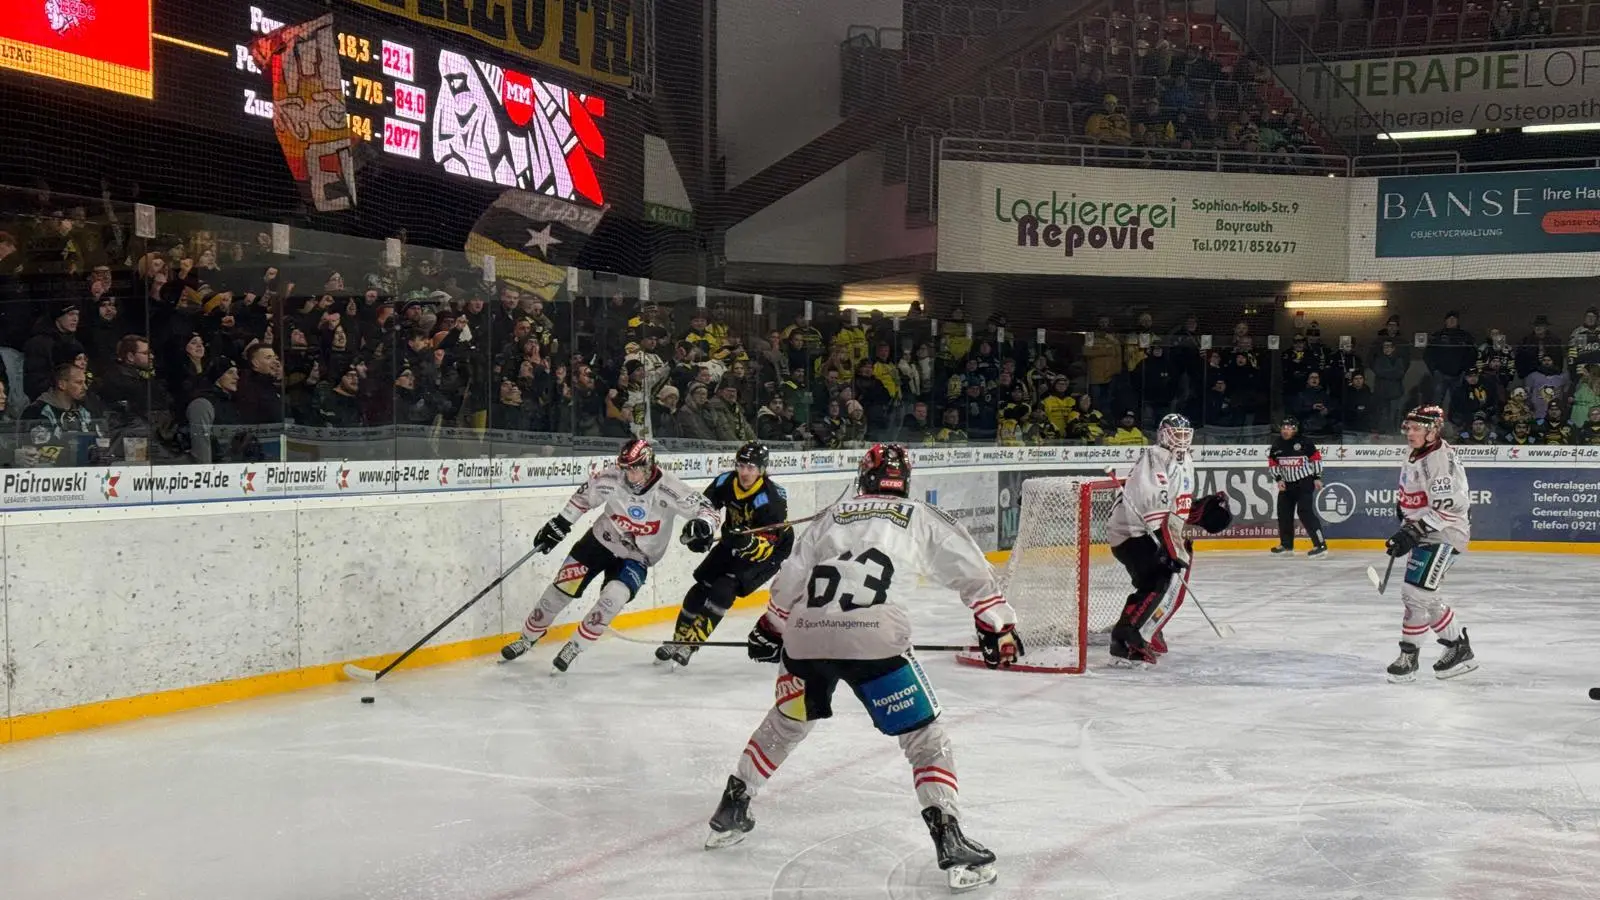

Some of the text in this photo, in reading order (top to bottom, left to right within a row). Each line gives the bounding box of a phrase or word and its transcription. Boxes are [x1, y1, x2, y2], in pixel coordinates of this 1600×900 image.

[337, 32, 370, 63] 18,3
[383, 46, 412, 75] 22,1
[353, 75, 383, 105] 77,6
[506, 81, 530, 105] MM
[384, 122, 420, 151] 2077
[1543, 187, 1572, 200] Ihre
[996, 188, 1177, 229] Lackiererei
[1383, 187, 1533, 220] BANSE
[1215, 218, 1273, 234] Bayreuth
[1411, 228, 1504, 239] OBJEKTVERWALTUNG
[1018, 214, 1154, 257] Repovic
[1074, 448, 1121, 459] www.pio-24.de
[1200, 447, 1259, 458] www.pio-24.de
[1528, 448, 1599, 459] www.pio-24.de
[266, 466, 327, 484] Piotrowski
[359, 466, 430, 485] www.pio-24.de
[457, 462, 503, 478] Piotrowski
[527, 463, 582, 480] www.pio-24.de
[4, 472, 87, 494] Piotrowski
[133, 471, 229, 495] www.pio-24.de
[1533, 493, 1598, 503] Telefon 0921
[1532, 520, 1597, 531] Telefon 0921
[872, 683, 918, 708] kontron
